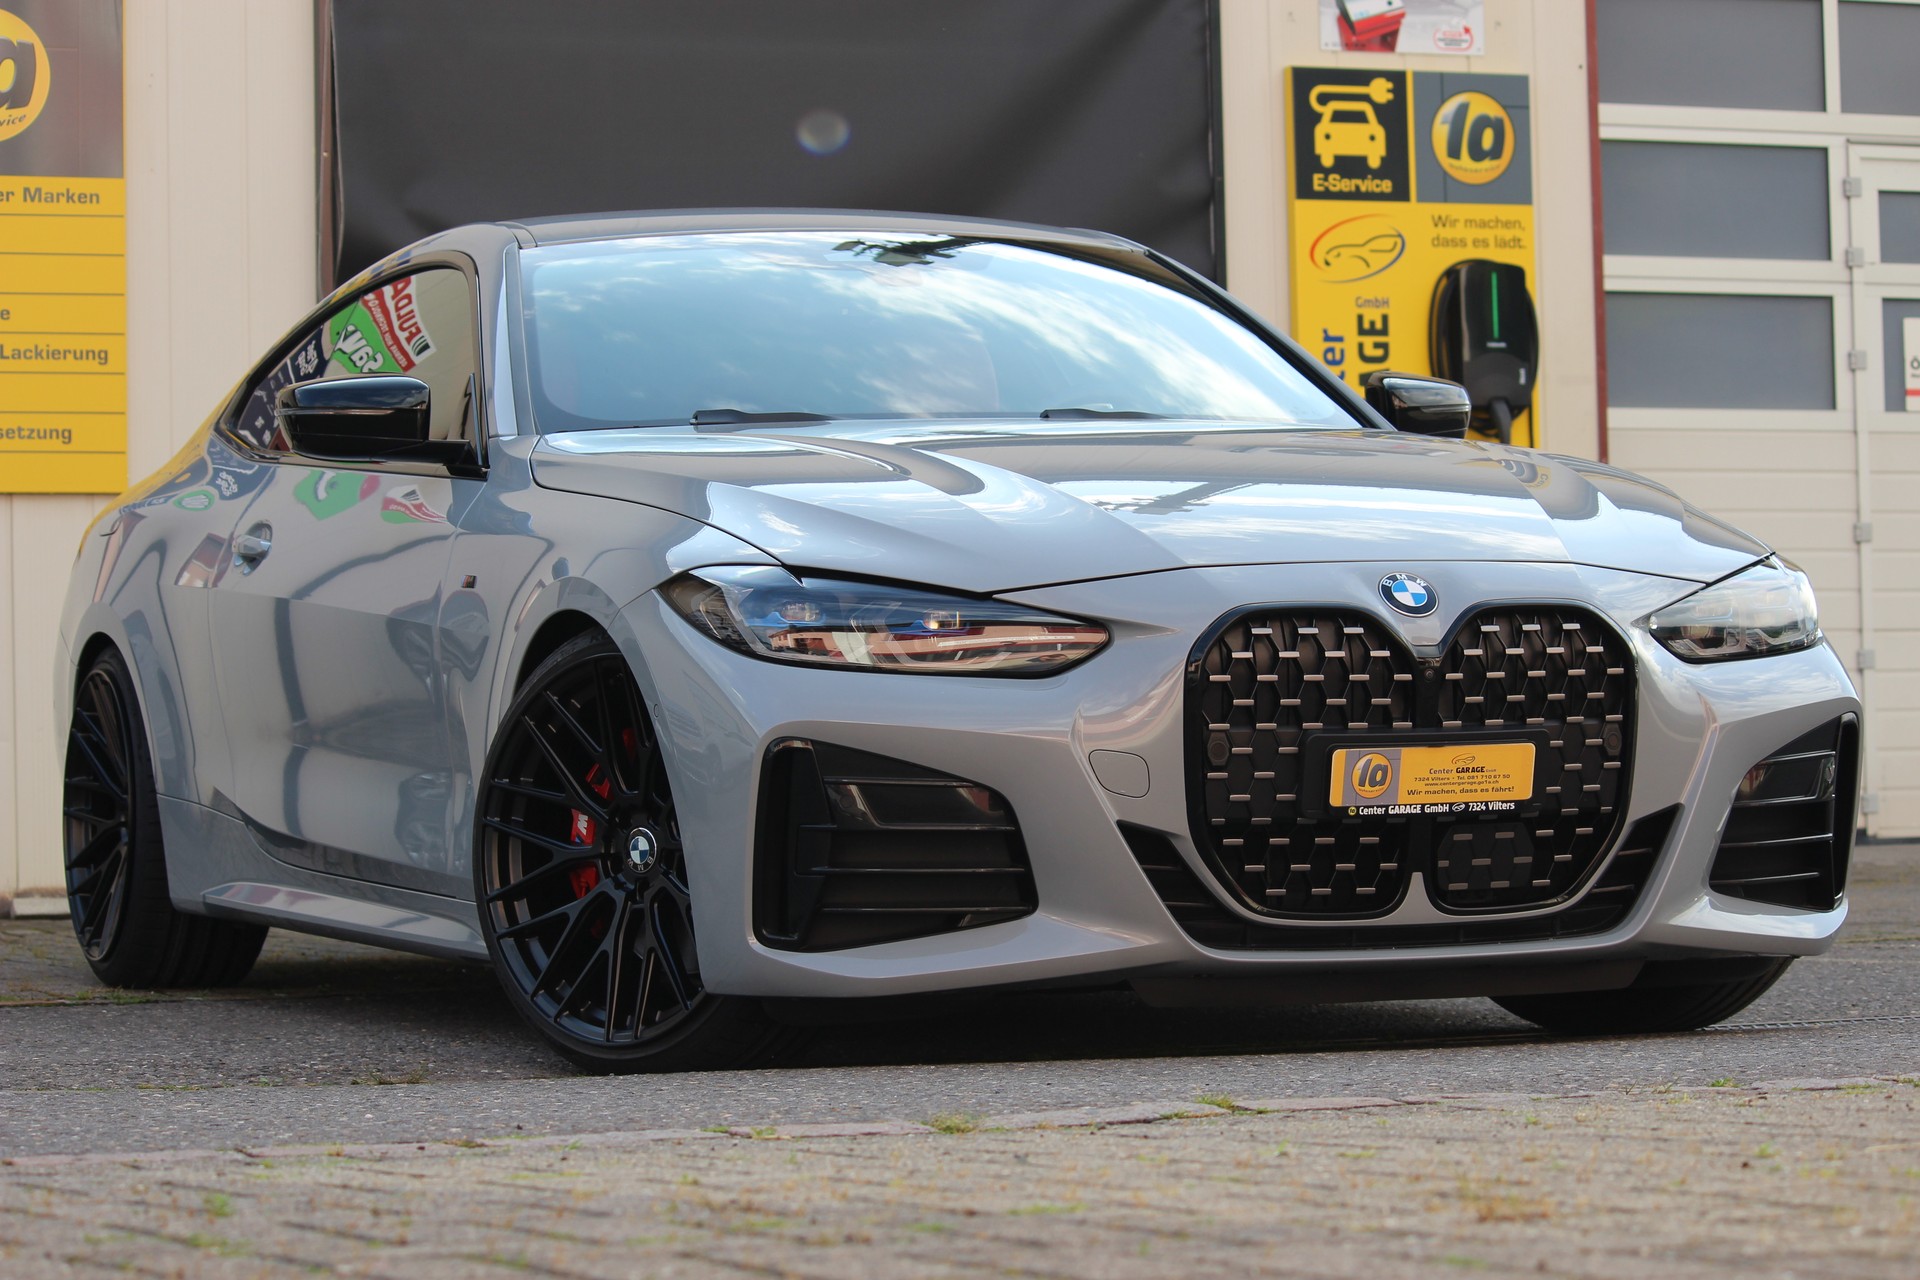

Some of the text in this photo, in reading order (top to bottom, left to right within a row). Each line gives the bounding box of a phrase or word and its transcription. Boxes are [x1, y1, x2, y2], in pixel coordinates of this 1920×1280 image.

[1312, 172, 1393, 194] E-Service
[23, 186, 100, 205] Marken
[1431, 214, 1526, 232] Wir machen,
[1431, 234, 1468, 249] dass
[1472, 237, 1490, 249] es
[1355, 296, 1390, 309] GmbH
[0, 344, 109, 366] Lackierung
[1455, 766, 1486, 774] GARAGE
[1359, 806, 1386, 815] Center
[1388, 804, 1422, 815] GARAGE
[1424, 804, 1450, 813] GmbH
[1468, 802, 1487, 811] 7324
[1488, 801, 1515, 810] Vilters
